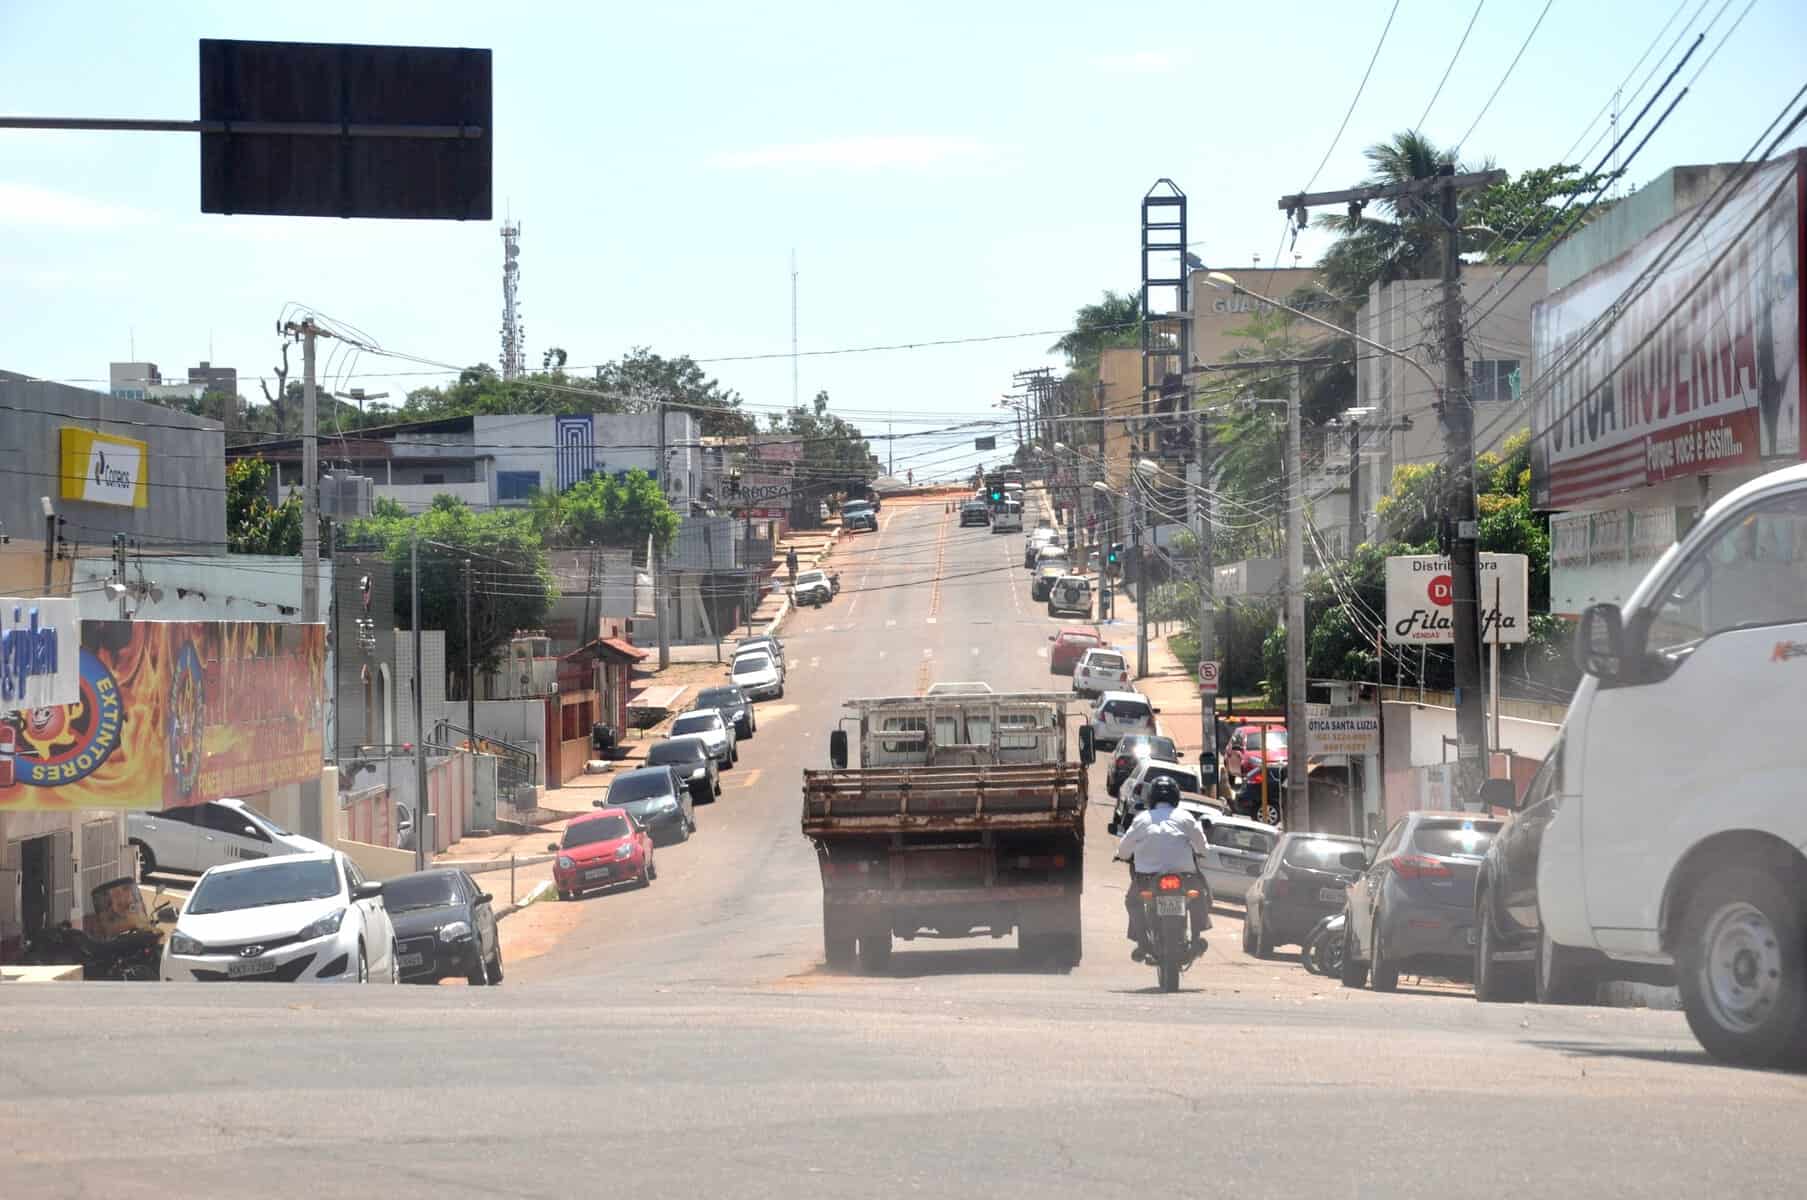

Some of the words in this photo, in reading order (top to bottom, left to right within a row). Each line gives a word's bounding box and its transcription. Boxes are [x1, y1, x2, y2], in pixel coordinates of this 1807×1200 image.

[1621, 246, 1758, 430] MODERNA
[1412, 560, 1497, 572] Distriora
[32, 677, 120, 781] EXTINTORES
[1331, 720, 1355, 731] SANTA
[1356, 720, 1378, 731] LUZIA
